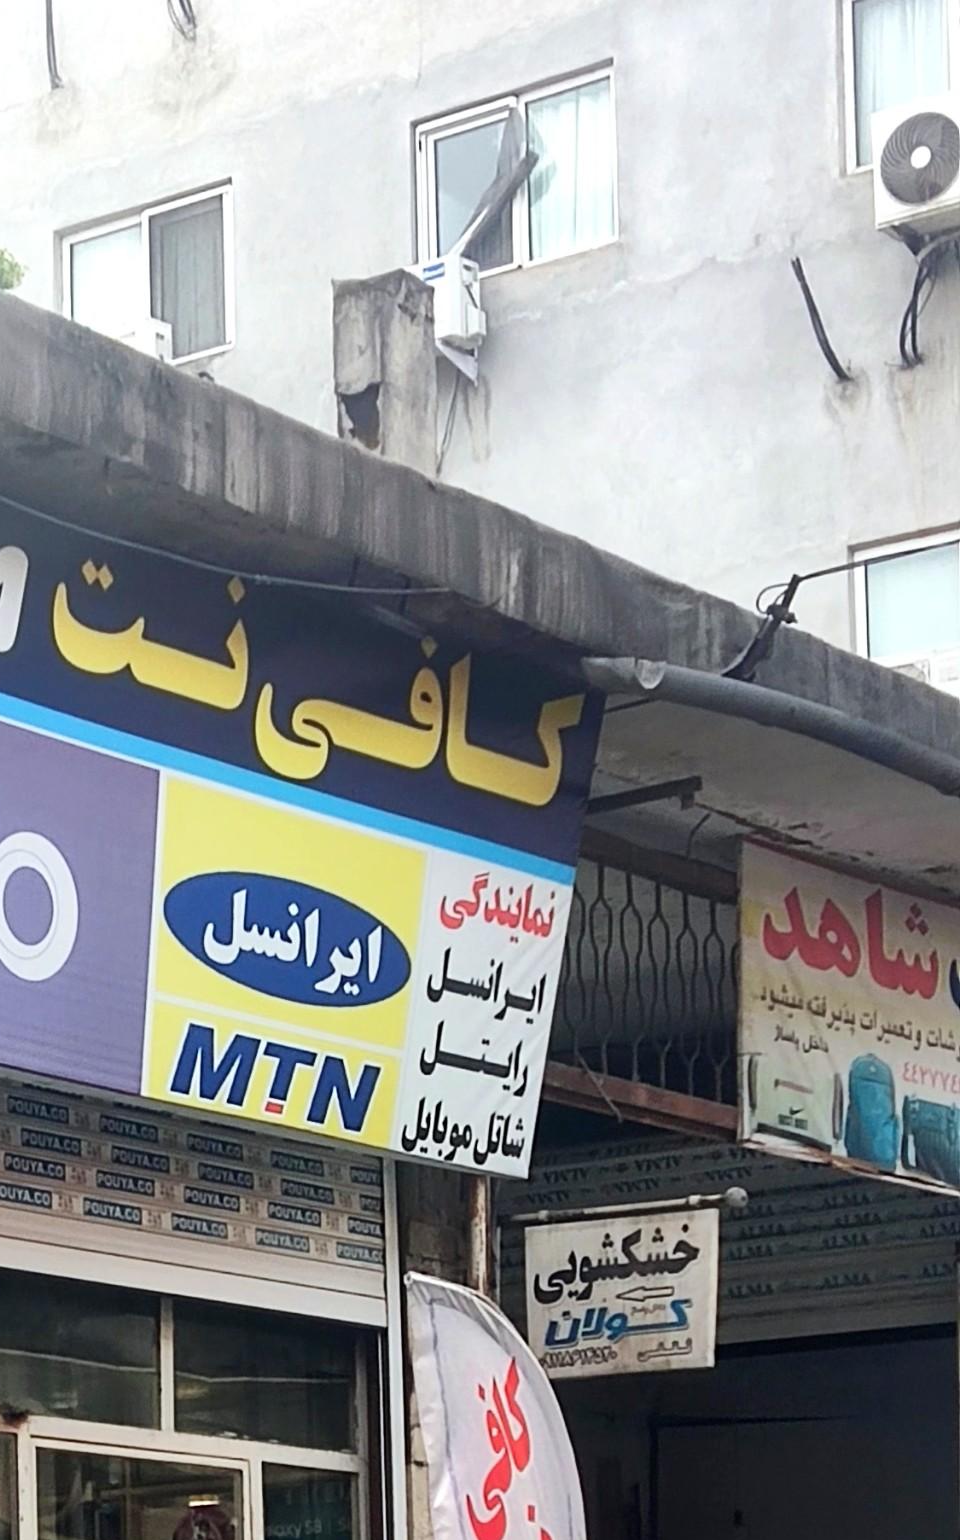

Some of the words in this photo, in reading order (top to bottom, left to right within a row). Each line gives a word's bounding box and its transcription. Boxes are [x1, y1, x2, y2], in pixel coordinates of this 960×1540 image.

[53, 558, 250, 711] نت
[255, 637, 583, 806] کافی
[202, 888, 383, 996] ایرانسل
[439, 871, 556, 942] نمایندگی
[763, 886, 939, 1000] شاهد
[426, 947, 546, 1020] ایرانسل
[169, 1022, 381, 1133] MTN
[419, 1020, 528, 1096] رایتل
[400, 1097, 472, 1165] موبایل
[472, 1105, 526, 1167] شاتل
[533, 1223, 701, 1304] خشکشویی
